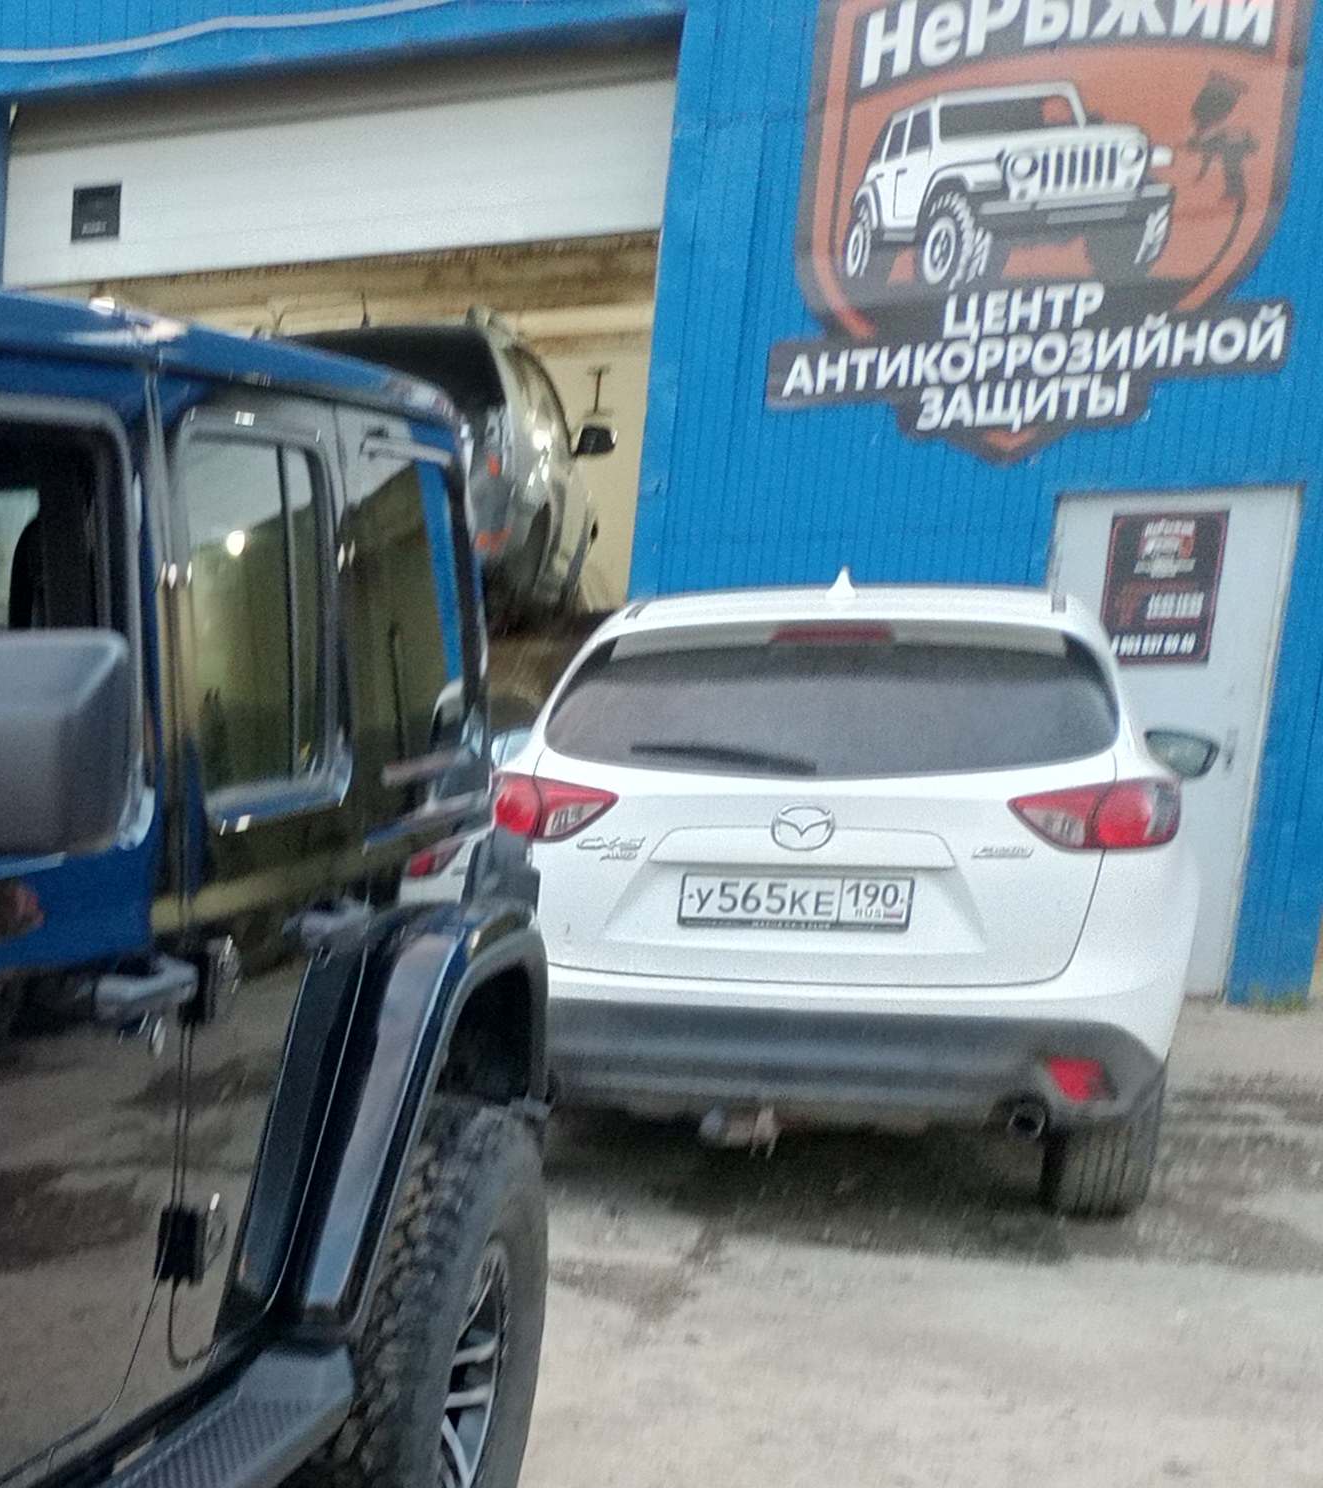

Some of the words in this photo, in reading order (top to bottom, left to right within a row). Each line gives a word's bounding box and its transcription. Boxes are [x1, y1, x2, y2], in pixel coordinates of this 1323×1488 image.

[942, 282, 1104, 341] ЦЕНТР
[782, 302, 1287, 397] АНТИКОРРОЗИЙНОЙ
[916, 372, 1130, 433] ЗАЩИТЫ
[696, 881, 835, 917] У565КЕ
[846, 883, 899, 908] 190
